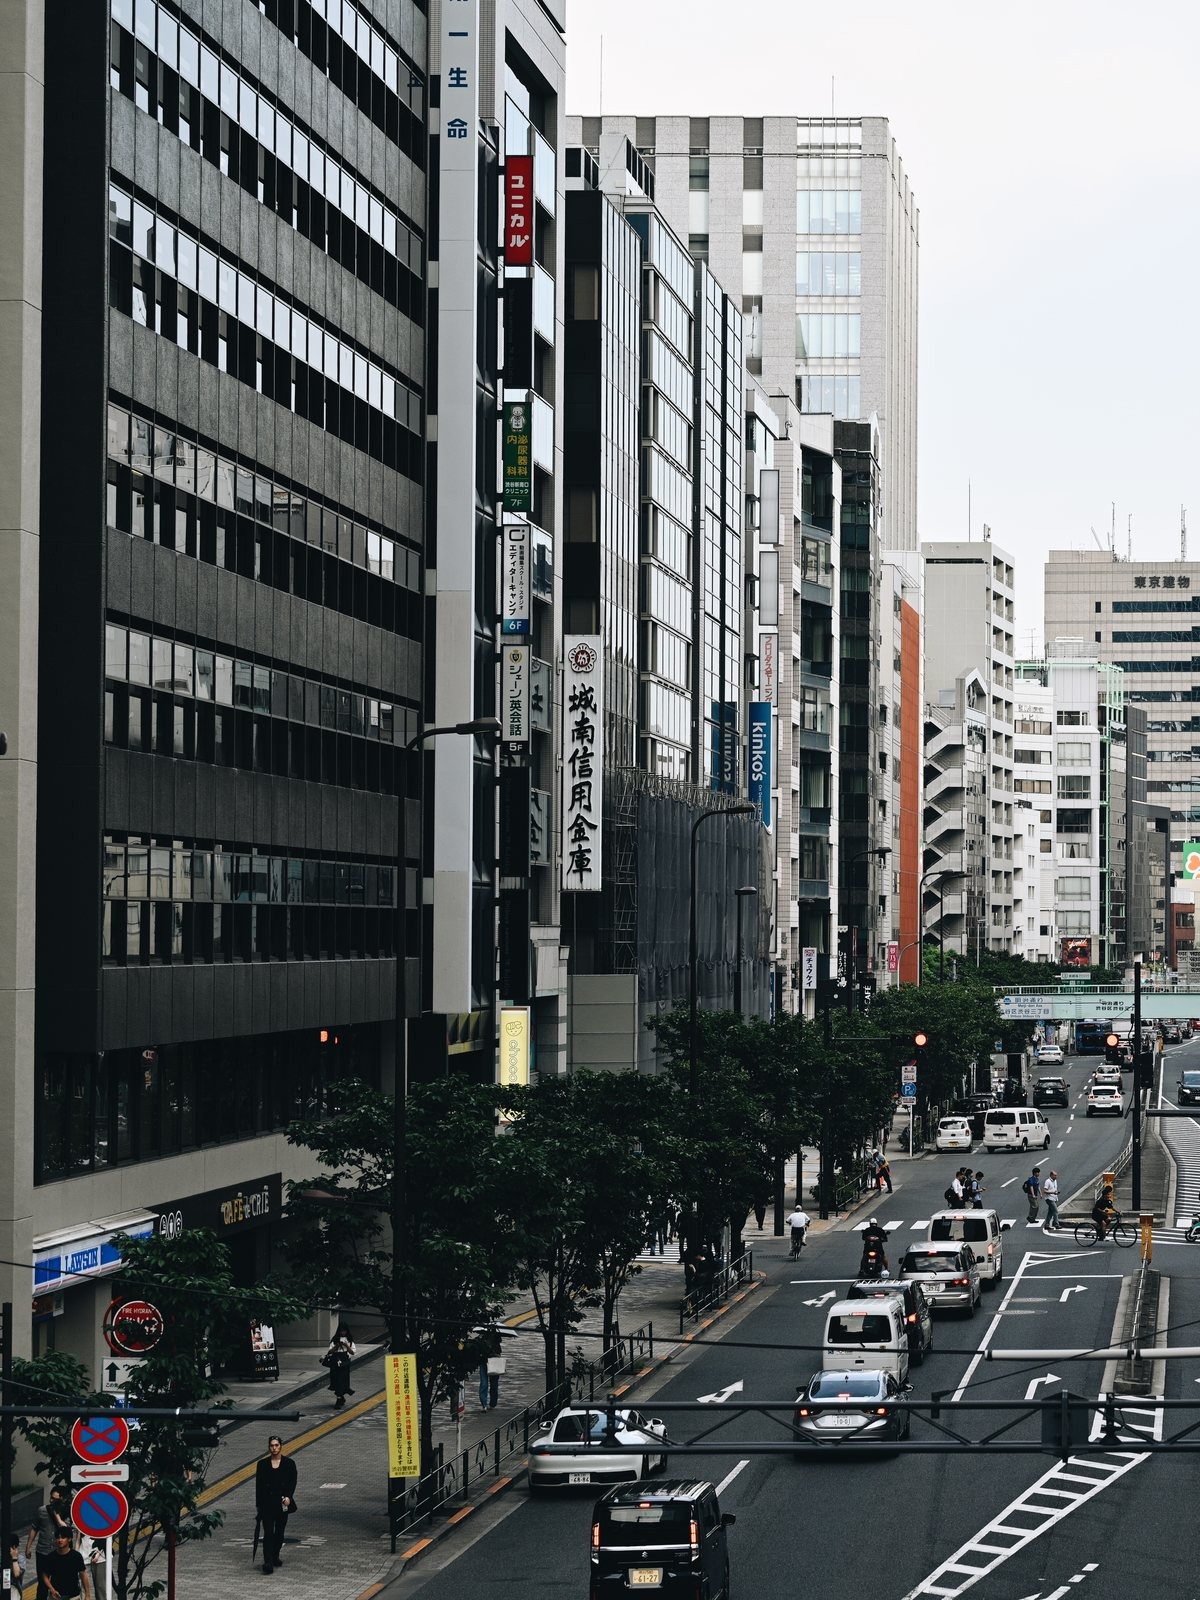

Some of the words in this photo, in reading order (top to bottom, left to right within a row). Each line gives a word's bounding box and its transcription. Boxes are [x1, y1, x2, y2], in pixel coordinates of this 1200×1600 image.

[447, 0, 469, 139] 一生命
[510, 175, 529, 248] ユニカル
[517, 434, 529, 476] 泌尿器科
[510, 498, 523, 507] 7F
[508, 544, 517, 616] エディターキャンプ
[1133, 575, 1191, 590] 東京建物
[509, 621, 522, 630] 6F
[508, 665, 523, 737] シェーン英会話
[508, 742, 523, 752] 5F
[751, 722, 767, 782] kinko's
[567, 682, 598, 883] 城南信用金庫
[805, 957, 813, 987] チュウケイ
[64, 1246, 99, 1273] LAWSON
